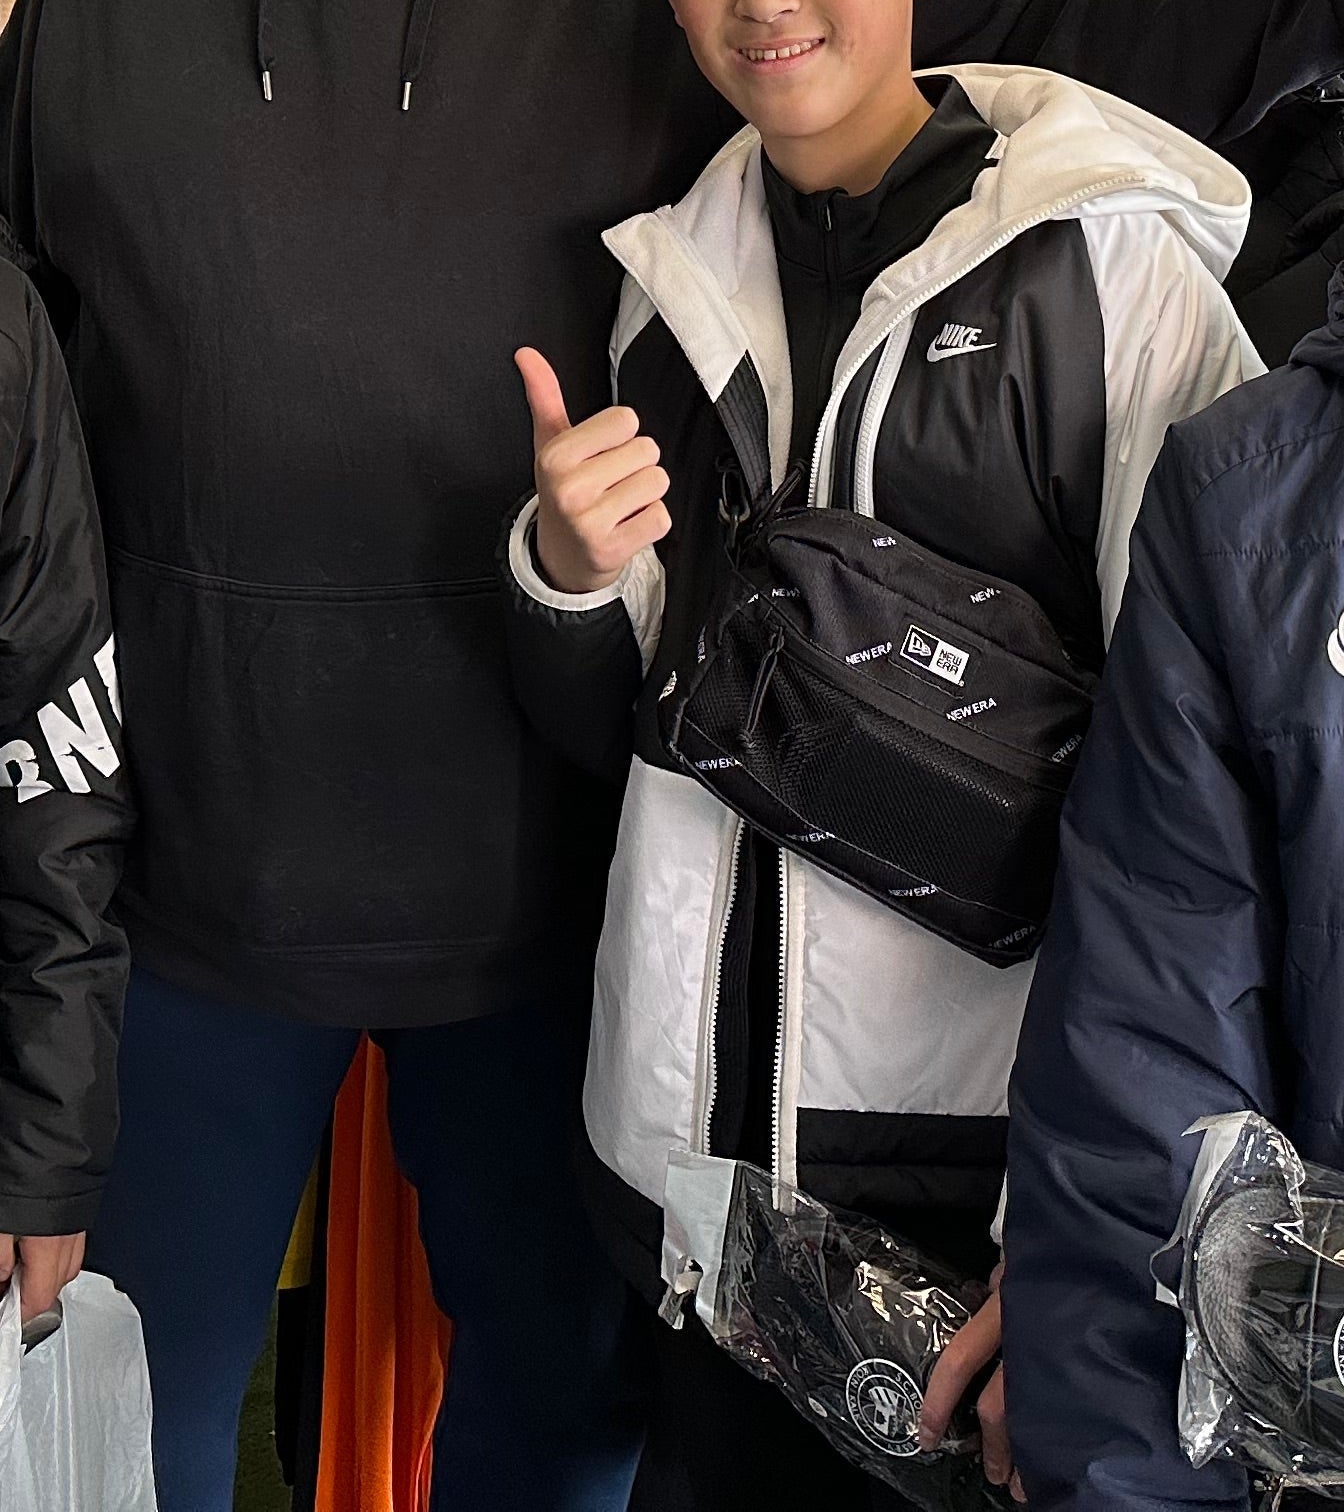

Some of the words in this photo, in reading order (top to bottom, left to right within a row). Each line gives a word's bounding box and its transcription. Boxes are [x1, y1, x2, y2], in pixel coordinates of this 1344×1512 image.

[936, 322, 983, 348] NIKE
[845, 649, 871, 665] NEW
[871, 641, 893, 658] ERA
[939, 648, 963, 666] NEW
[936, 659, 959, 675] ERA
[946, 704, 972, 721] NEW
[972, 697, 997, 714] ERA
